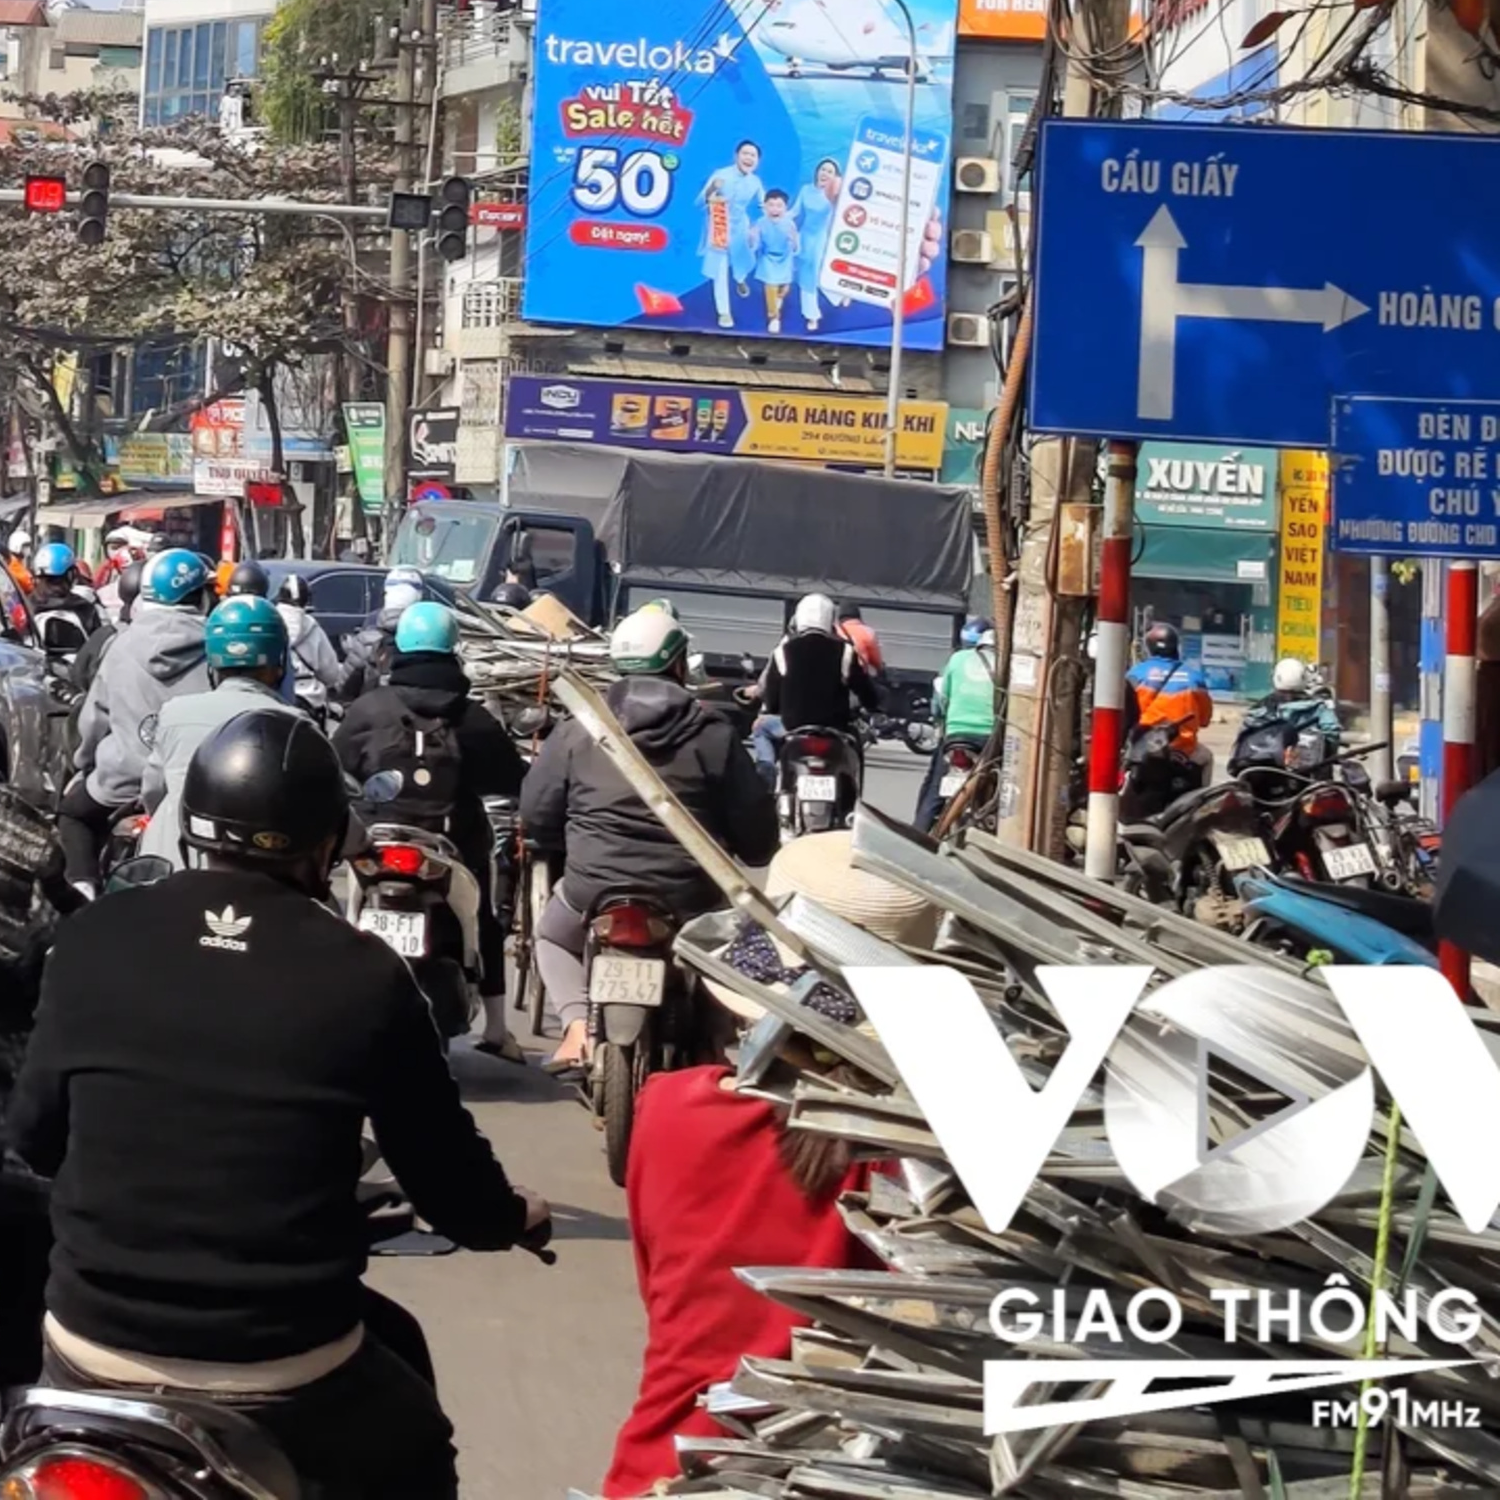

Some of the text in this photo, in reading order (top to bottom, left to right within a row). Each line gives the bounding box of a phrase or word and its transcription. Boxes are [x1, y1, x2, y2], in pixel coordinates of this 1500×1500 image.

[545, 33, 716, 74] traveloka
[626, 74, 675, 109] Tết
[567, 102, 685, 139] Sale hết
[572, 146, 672, 214] 50
[1171, 152, 1240, 197] GIẤY
[1378, 284, 1482, 331] HOÀNG
[761, 400, 799, 424] CỬA
[804, 403, 856, 428] HÀNG
[902, 411, 936, 434] KHÍ
[1146, 450, 1265, 496] XUYẾN
[1377, 447, 1446, 485] ĐƯỢC
[1455, 445, 1488, 480] RẼ
[1287, 491, 1319, 514] YẾN
[1429, 482, 1481, 517] CHÚ
[1407, 516, 1462, 545] ĐƯỜNG
[1464, 524, 1497, 546] CHO
[1284, 546, 1318, 565] VIỆT
[1283, 570, 1317, 587] NAM
[371, 911, 415, 934] 38-F1
[199, 936, 247, 952] adidas
[603, 960, 654, 981] 29-T1
